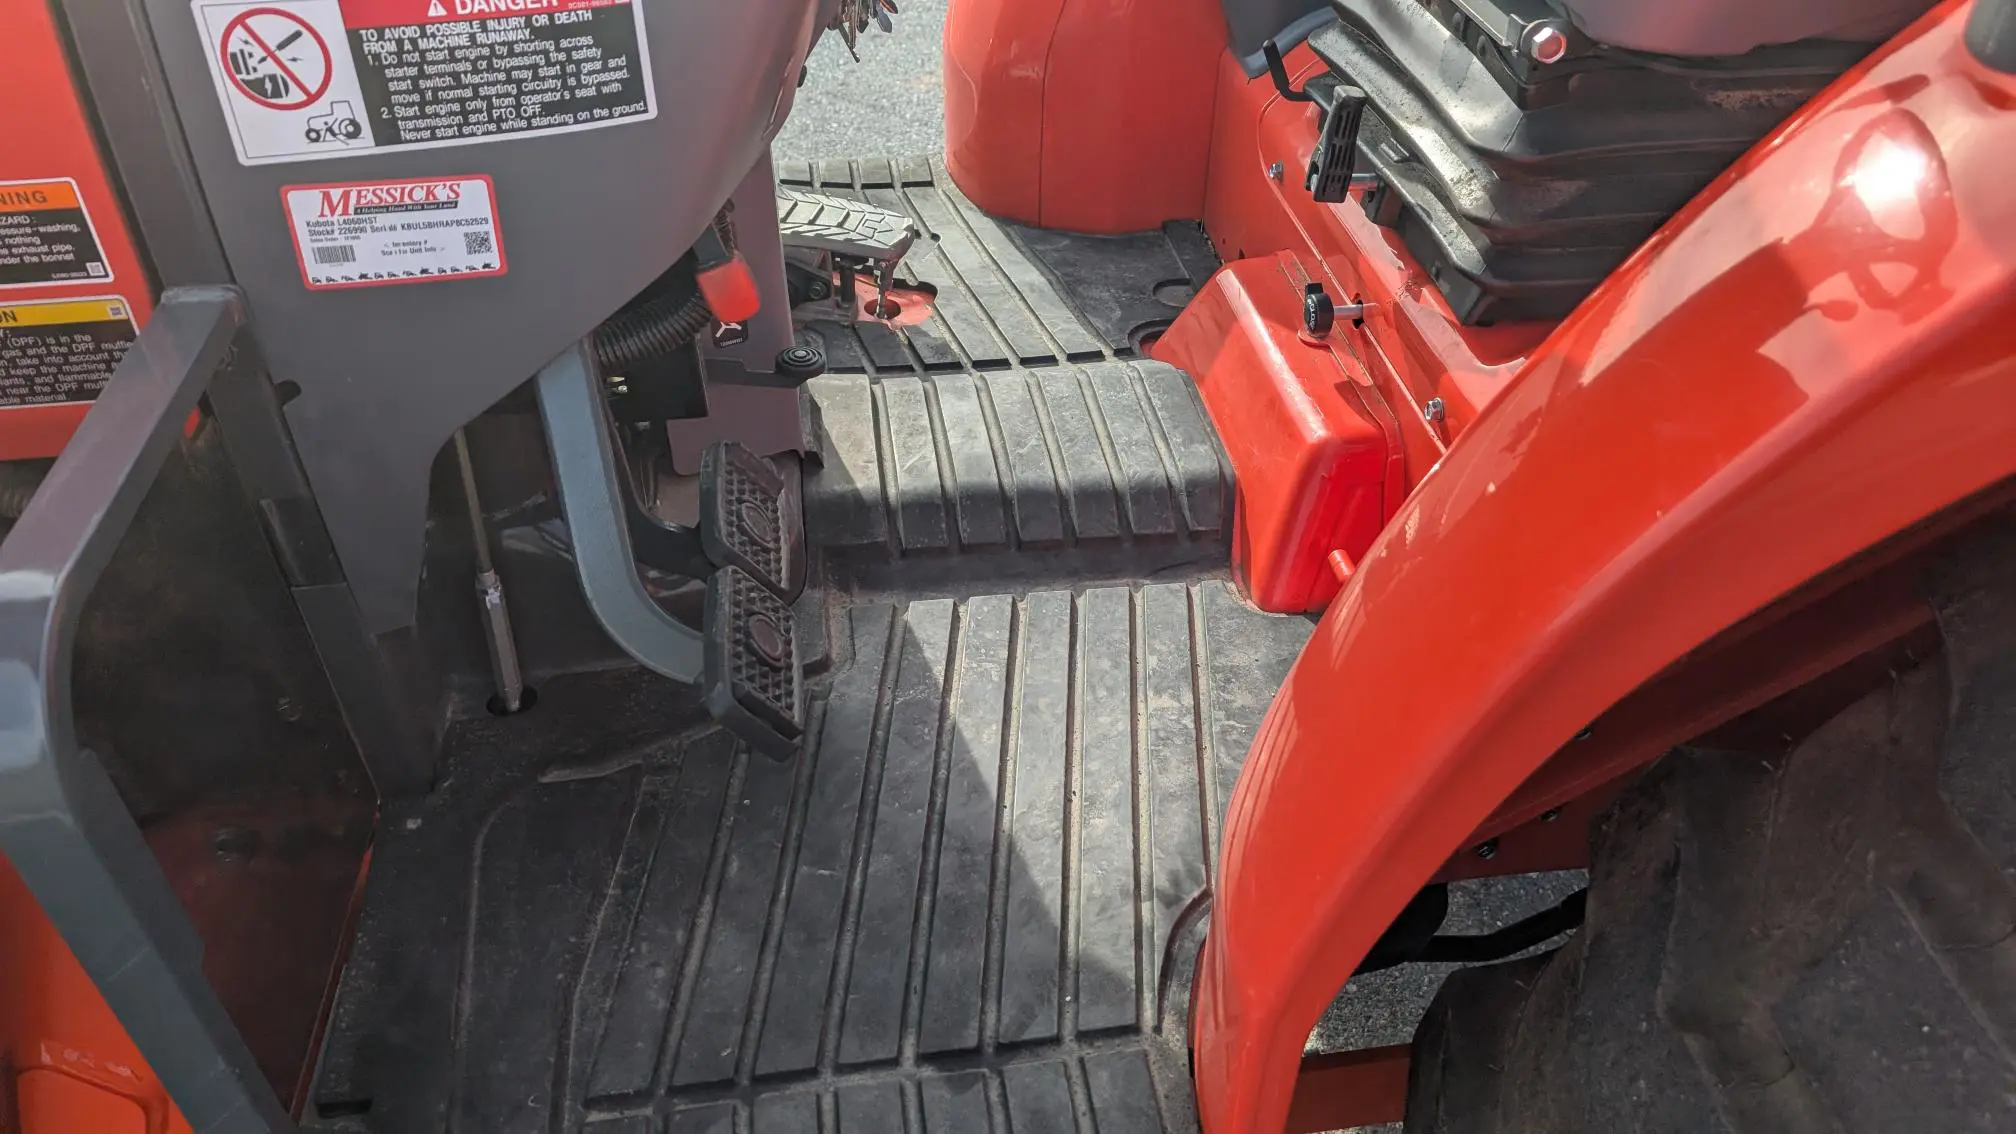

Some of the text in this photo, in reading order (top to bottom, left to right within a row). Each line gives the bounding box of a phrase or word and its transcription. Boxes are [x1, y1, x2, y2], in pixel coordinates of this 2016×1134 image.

[359, 9, 593, 41] TO AVOID POSSIBLE INJURY OR DEATH
[363, 28, 535, 54] FROM A MACHINE RUNAWAY.
[367, 35, 593, 66] 1. Do not start engine by shorting across
[384, 47, 601, 78] starter terminals or bypassing the safety
[388, 54, 627, 91] start switch. Machine may start in gear and
[390, 68, 630, 104] move if normal starting circuitry is bypassed.
[380, 82, 622, 119] 2. Start engine only from operator's seat with
[397, 104, 546, 130] transmission and PTO OFF.
[400, 100, 647, 141] Never start engine while standing on the ground.
[318, 182, 461, 218] MESSICK'S
[305, 219, 335, 229] Kubota
[4, 236, 41, 245] nothing
[11, 244, 49, 254] exhaust
[23, 255, 40, 263] the
[41, 252, 75, 262] bonnet
[2, 350, 22, 359] gas
[26, 346, 47, 355] and
[51, 345, 69, 353] the
[72, 342, 96, 352] DPF
[7, 333, 92, 349] (DPF) is in the
[10, 367, 37, 376] keep
[40, 365, 58, 373] the
[62, 362, 106, 372] machine
[16, 357, 40, 366] take
[43, 355, 64, 364] into
[68, 351, 110, 362] account
[6, 386, 29, 395] near
[33, 385, 52, 393] the
[55, 382, 78, 391] DPF
[34, 375, 54, 384] and
